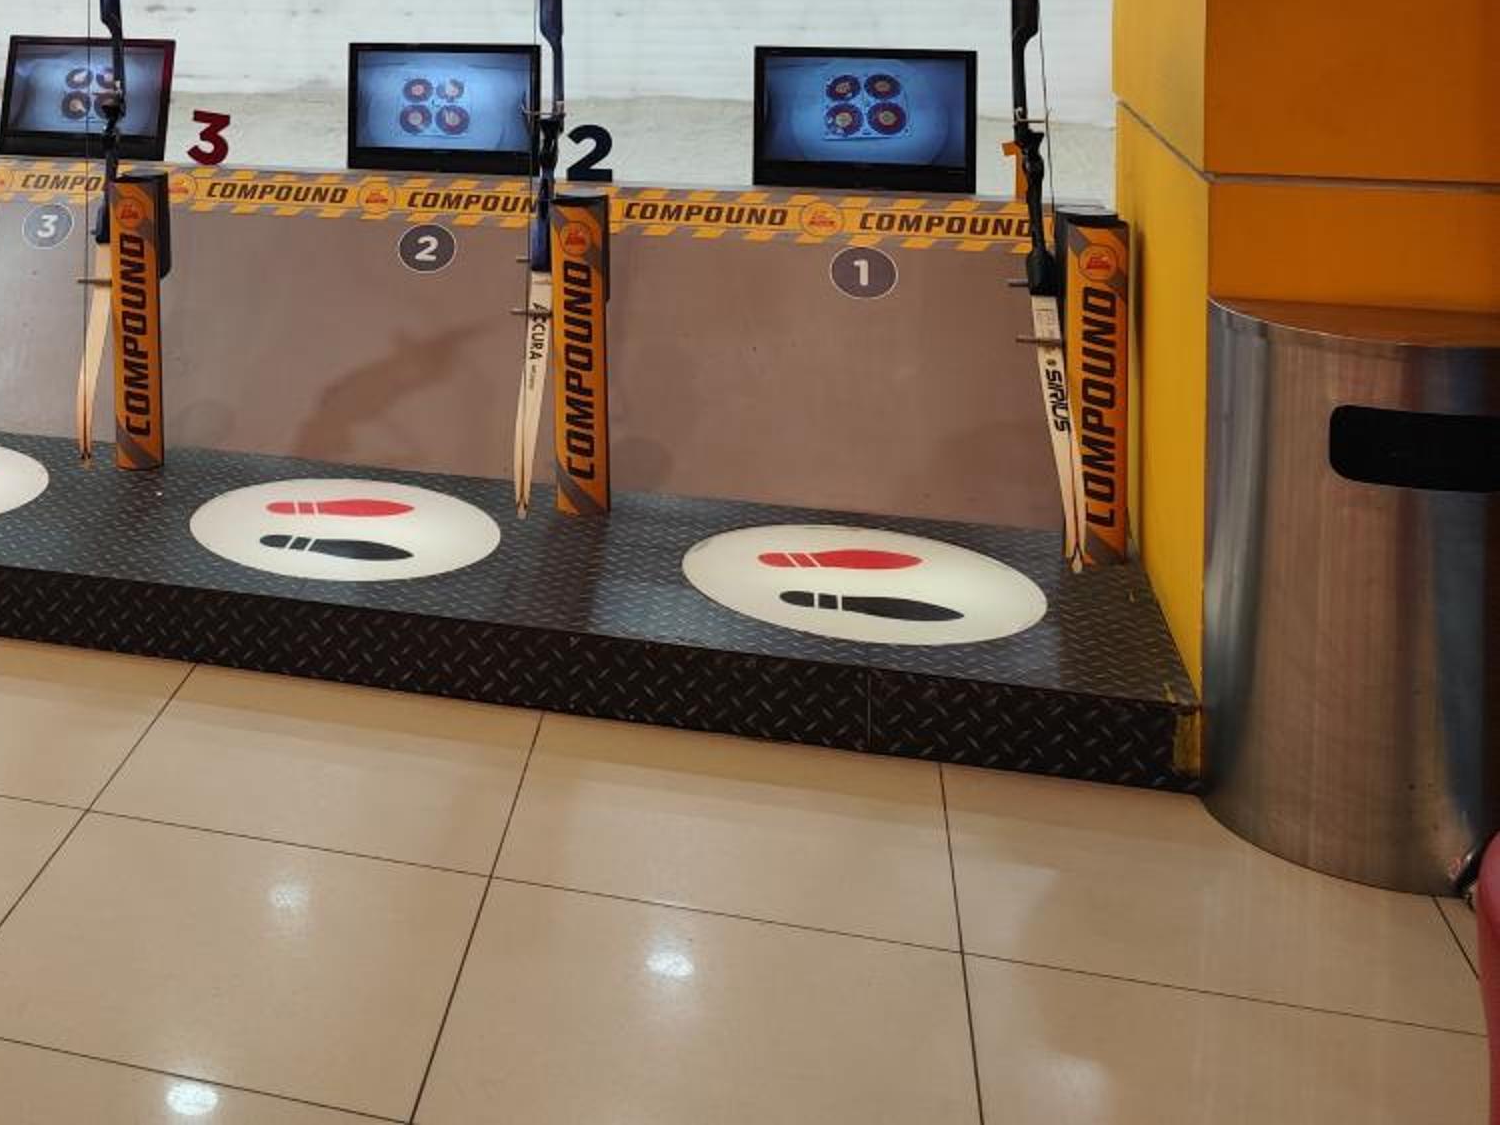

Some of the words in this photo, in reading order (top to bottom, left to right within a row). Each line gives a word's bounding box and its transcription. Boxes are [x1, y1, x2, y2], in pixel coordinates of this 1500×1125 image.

[187, 110, 231, 165] 3
[566, 124, 613, 182] 2
[206, 182, 349, 204] COMPOUND
[407, 190, 538, 214] COMPOUN
[37, 213, 58, 238] 3
[624, 202, 789, 227] COMPOUND
[859, 211, 1032, 238] COMPOUND
[414, 235, 439, 261] 2
[853, 259, 869, 286] 1
[119, 232, 150, 436] COMPOUND
[563, 260, 595, 481] COMPOUND
[1045, 369, 1072, 432] SIRIUS
